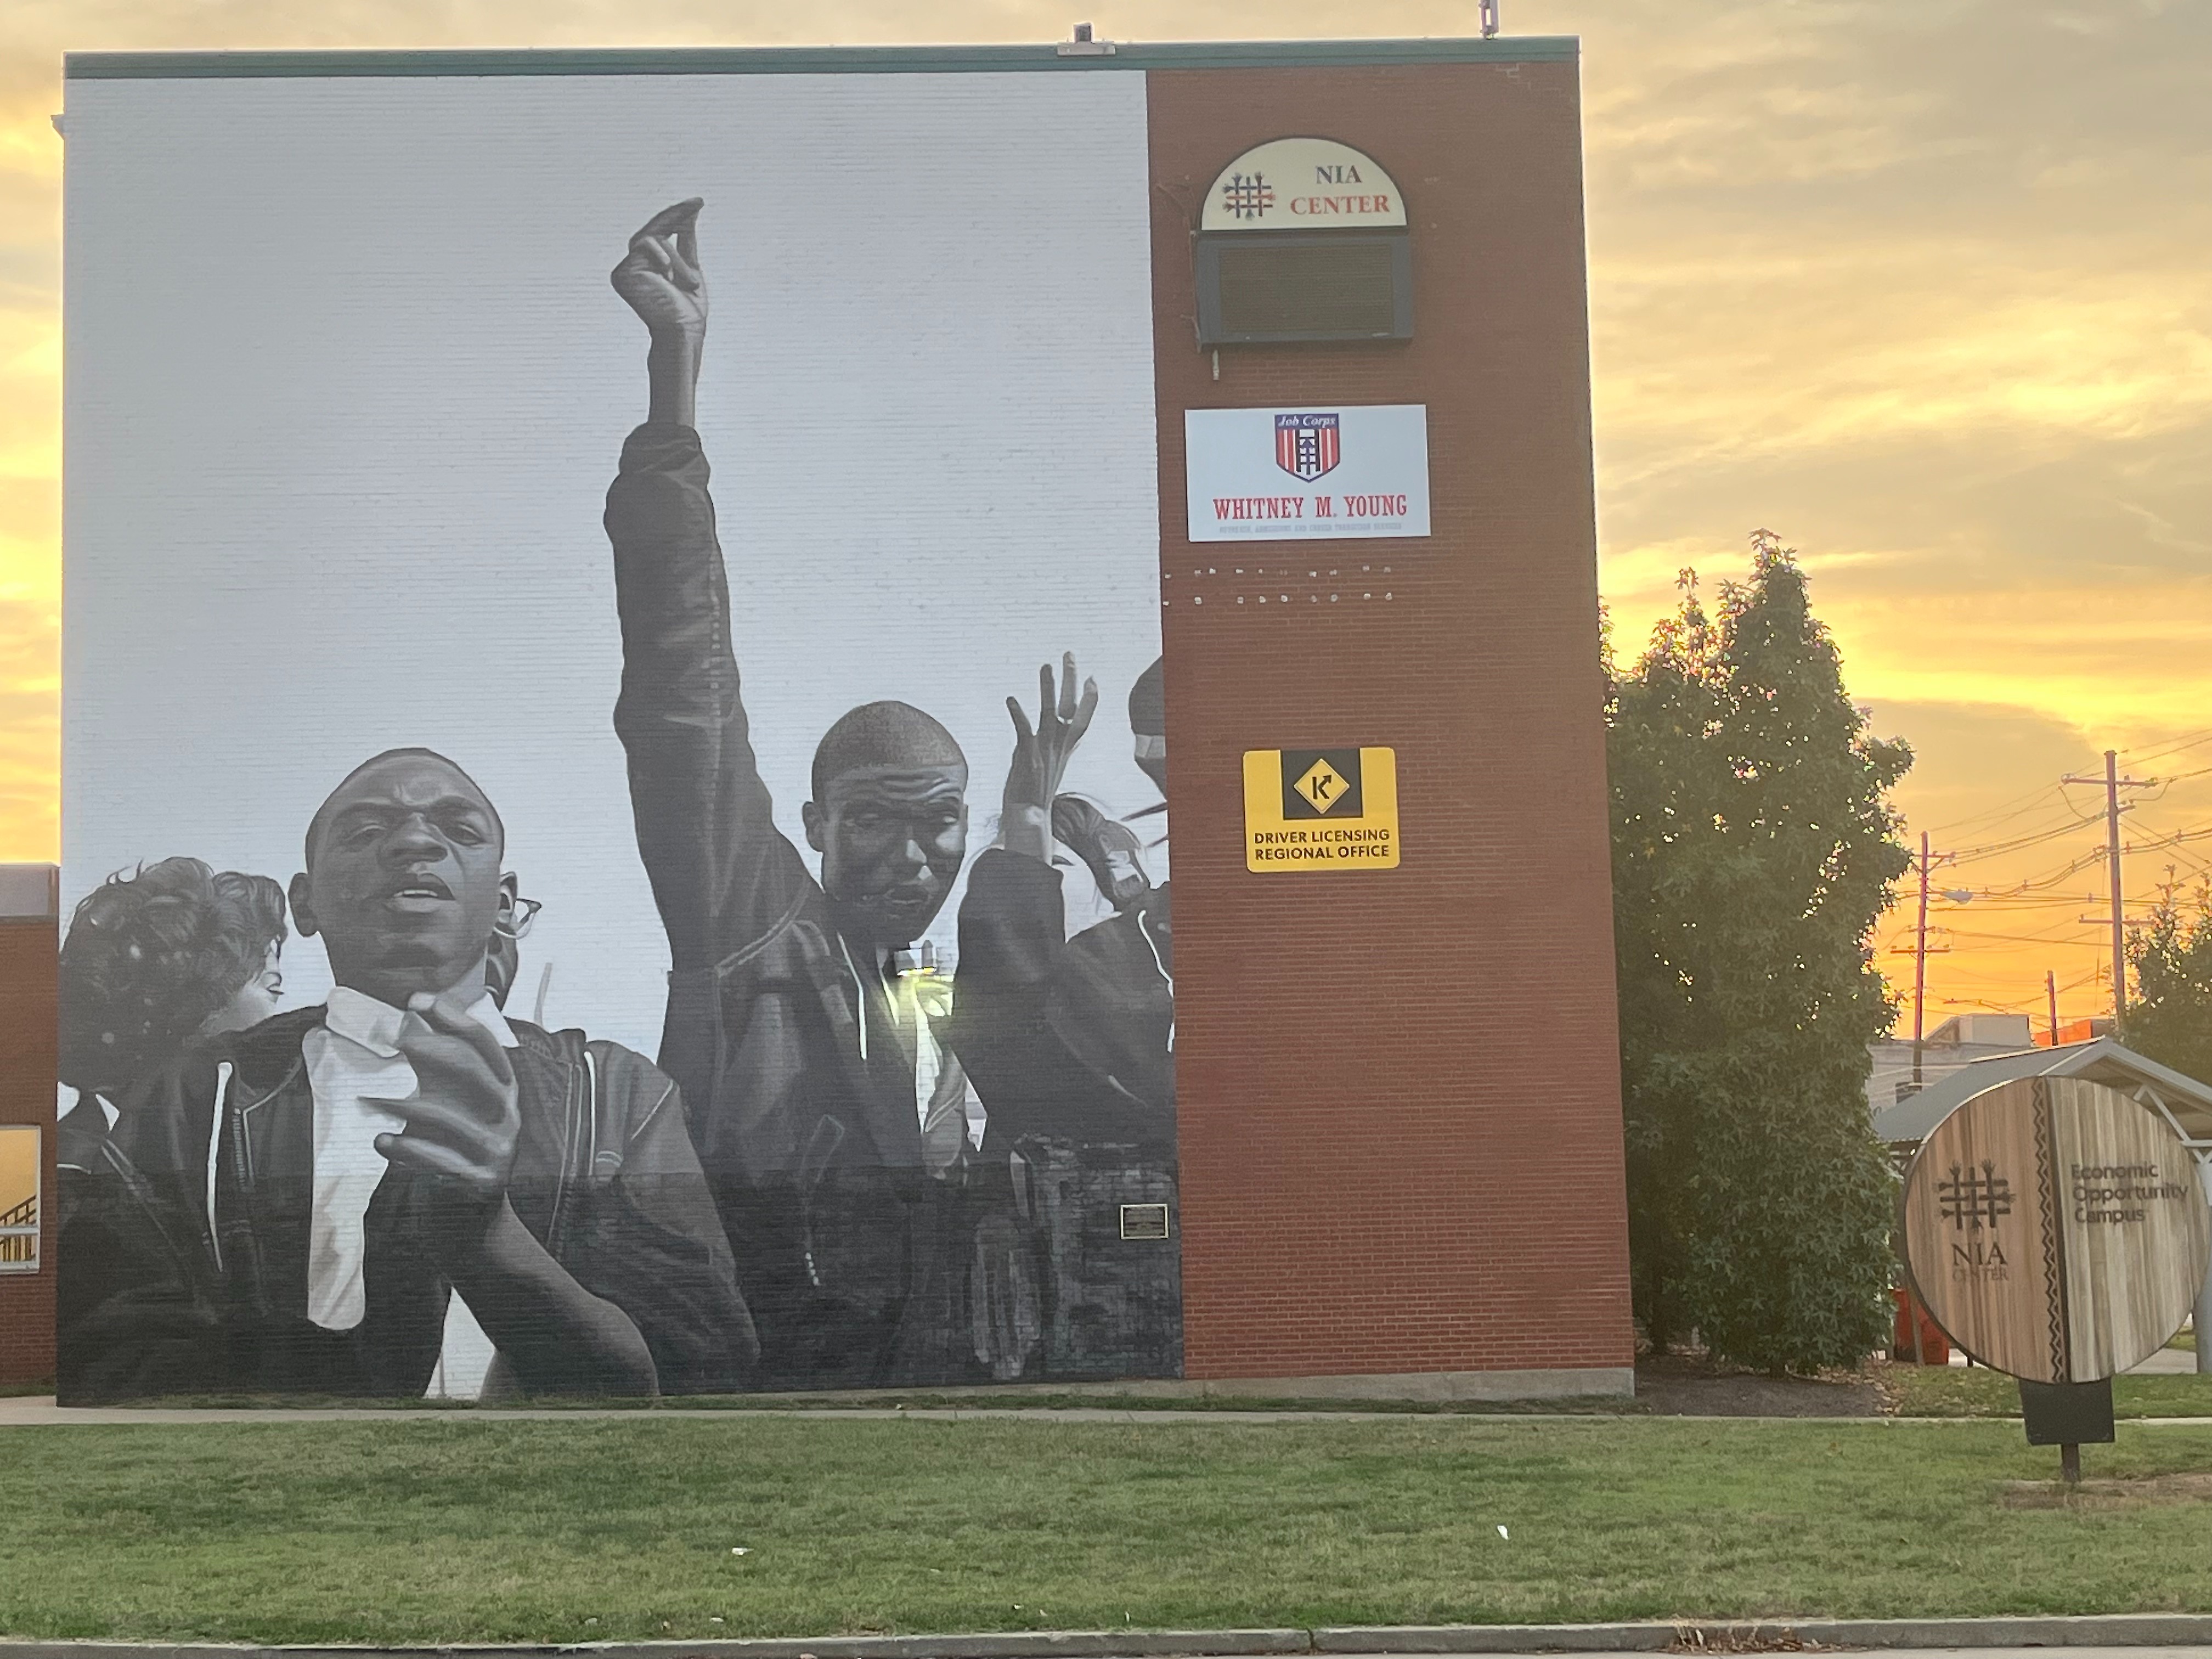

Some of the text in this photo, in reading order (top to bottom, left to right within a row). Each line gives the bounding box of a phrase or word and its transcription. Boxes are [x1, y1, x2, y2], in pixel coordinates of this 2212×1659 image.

[1316, 165, 1362, 184] NIA
[1290, 194, 1390, 215] CENTER
[1278, 415, 1336, 428] Job Corps
[1212, 494, 1408, 520] WHITNEY M. YOUNG
[1254, 829, 1390, 844] DRIVER LICENSING
[1255, 844, 1390, 861] REGIONAL OFFICE
[2070, 1160, 2159, 1180] Economic
[2072, 1182, 2188, 1205] Opportunity
[2074, 1207, 2146, 1226] Campus
[1951, 1241, 2008, 1266] NIA
